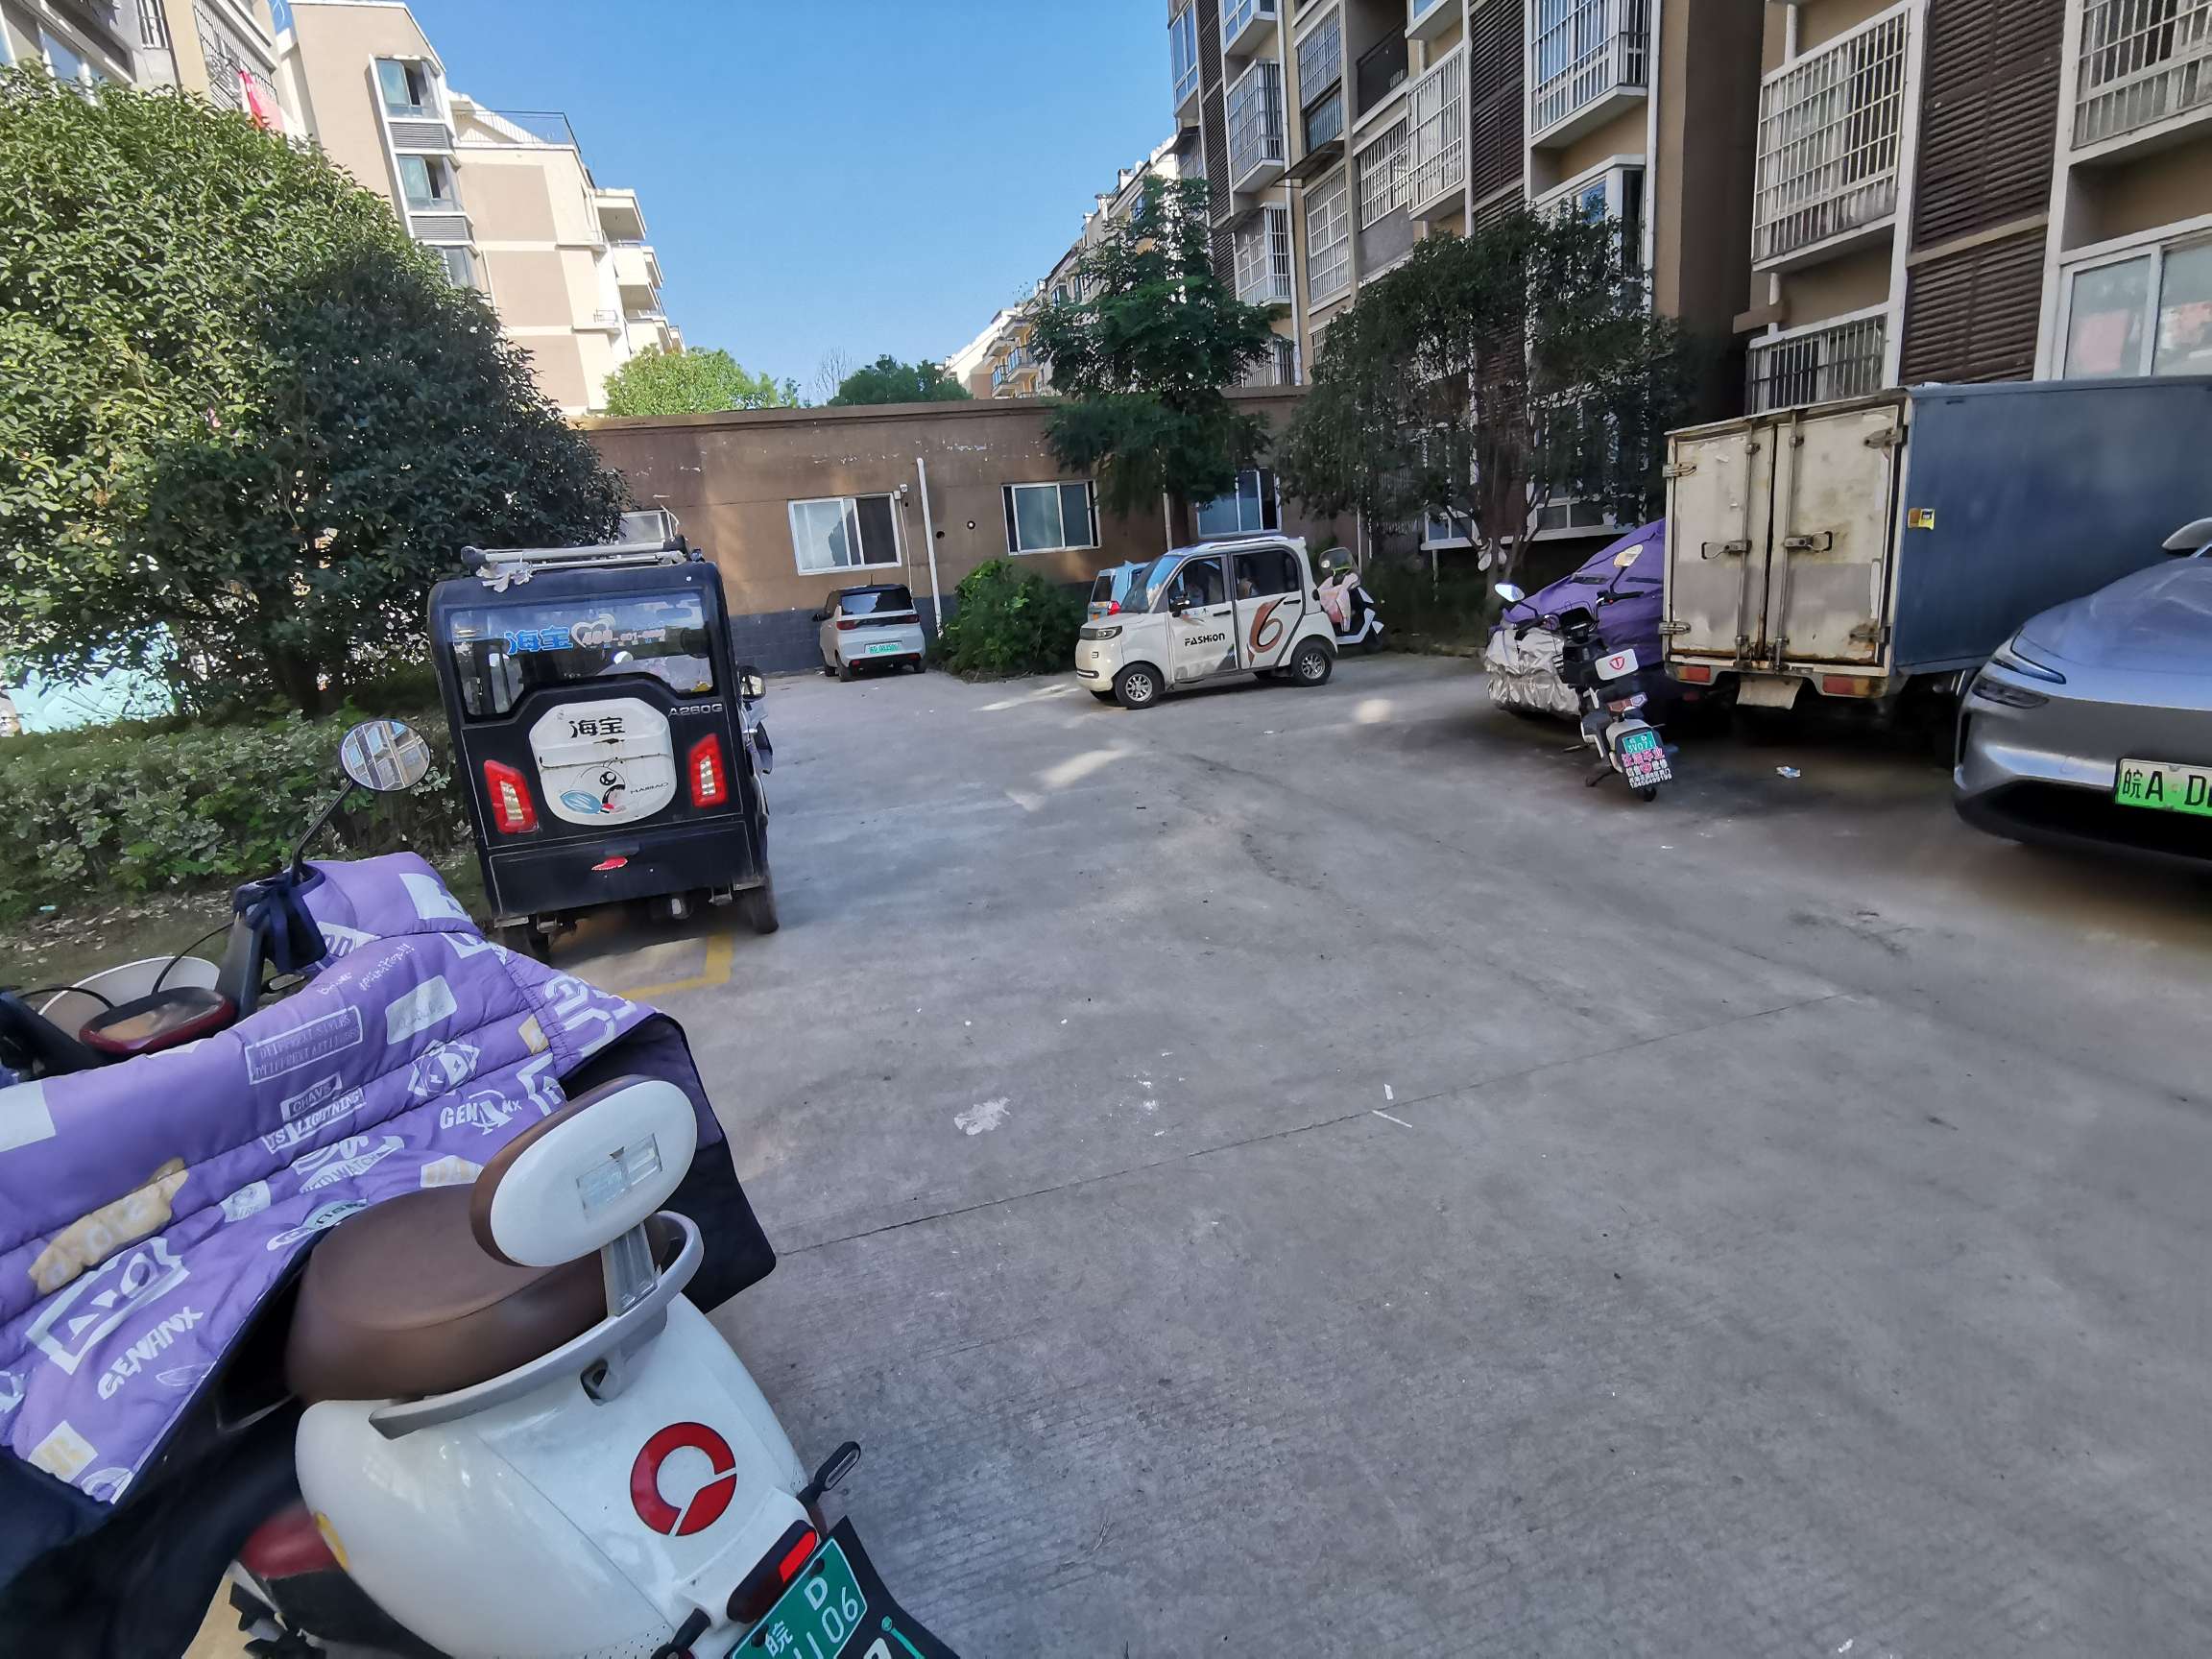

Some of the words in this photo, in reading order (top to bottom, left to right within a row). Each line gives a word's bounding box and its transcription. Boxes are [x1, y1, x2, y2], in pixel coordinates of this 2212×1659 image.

[504, 625, 573, 656] 海宝
[568, 716, 626, 739] 海宝
[98, 1307, 204, 1400] GENANX
[804, 1577, 829, 1611] D
